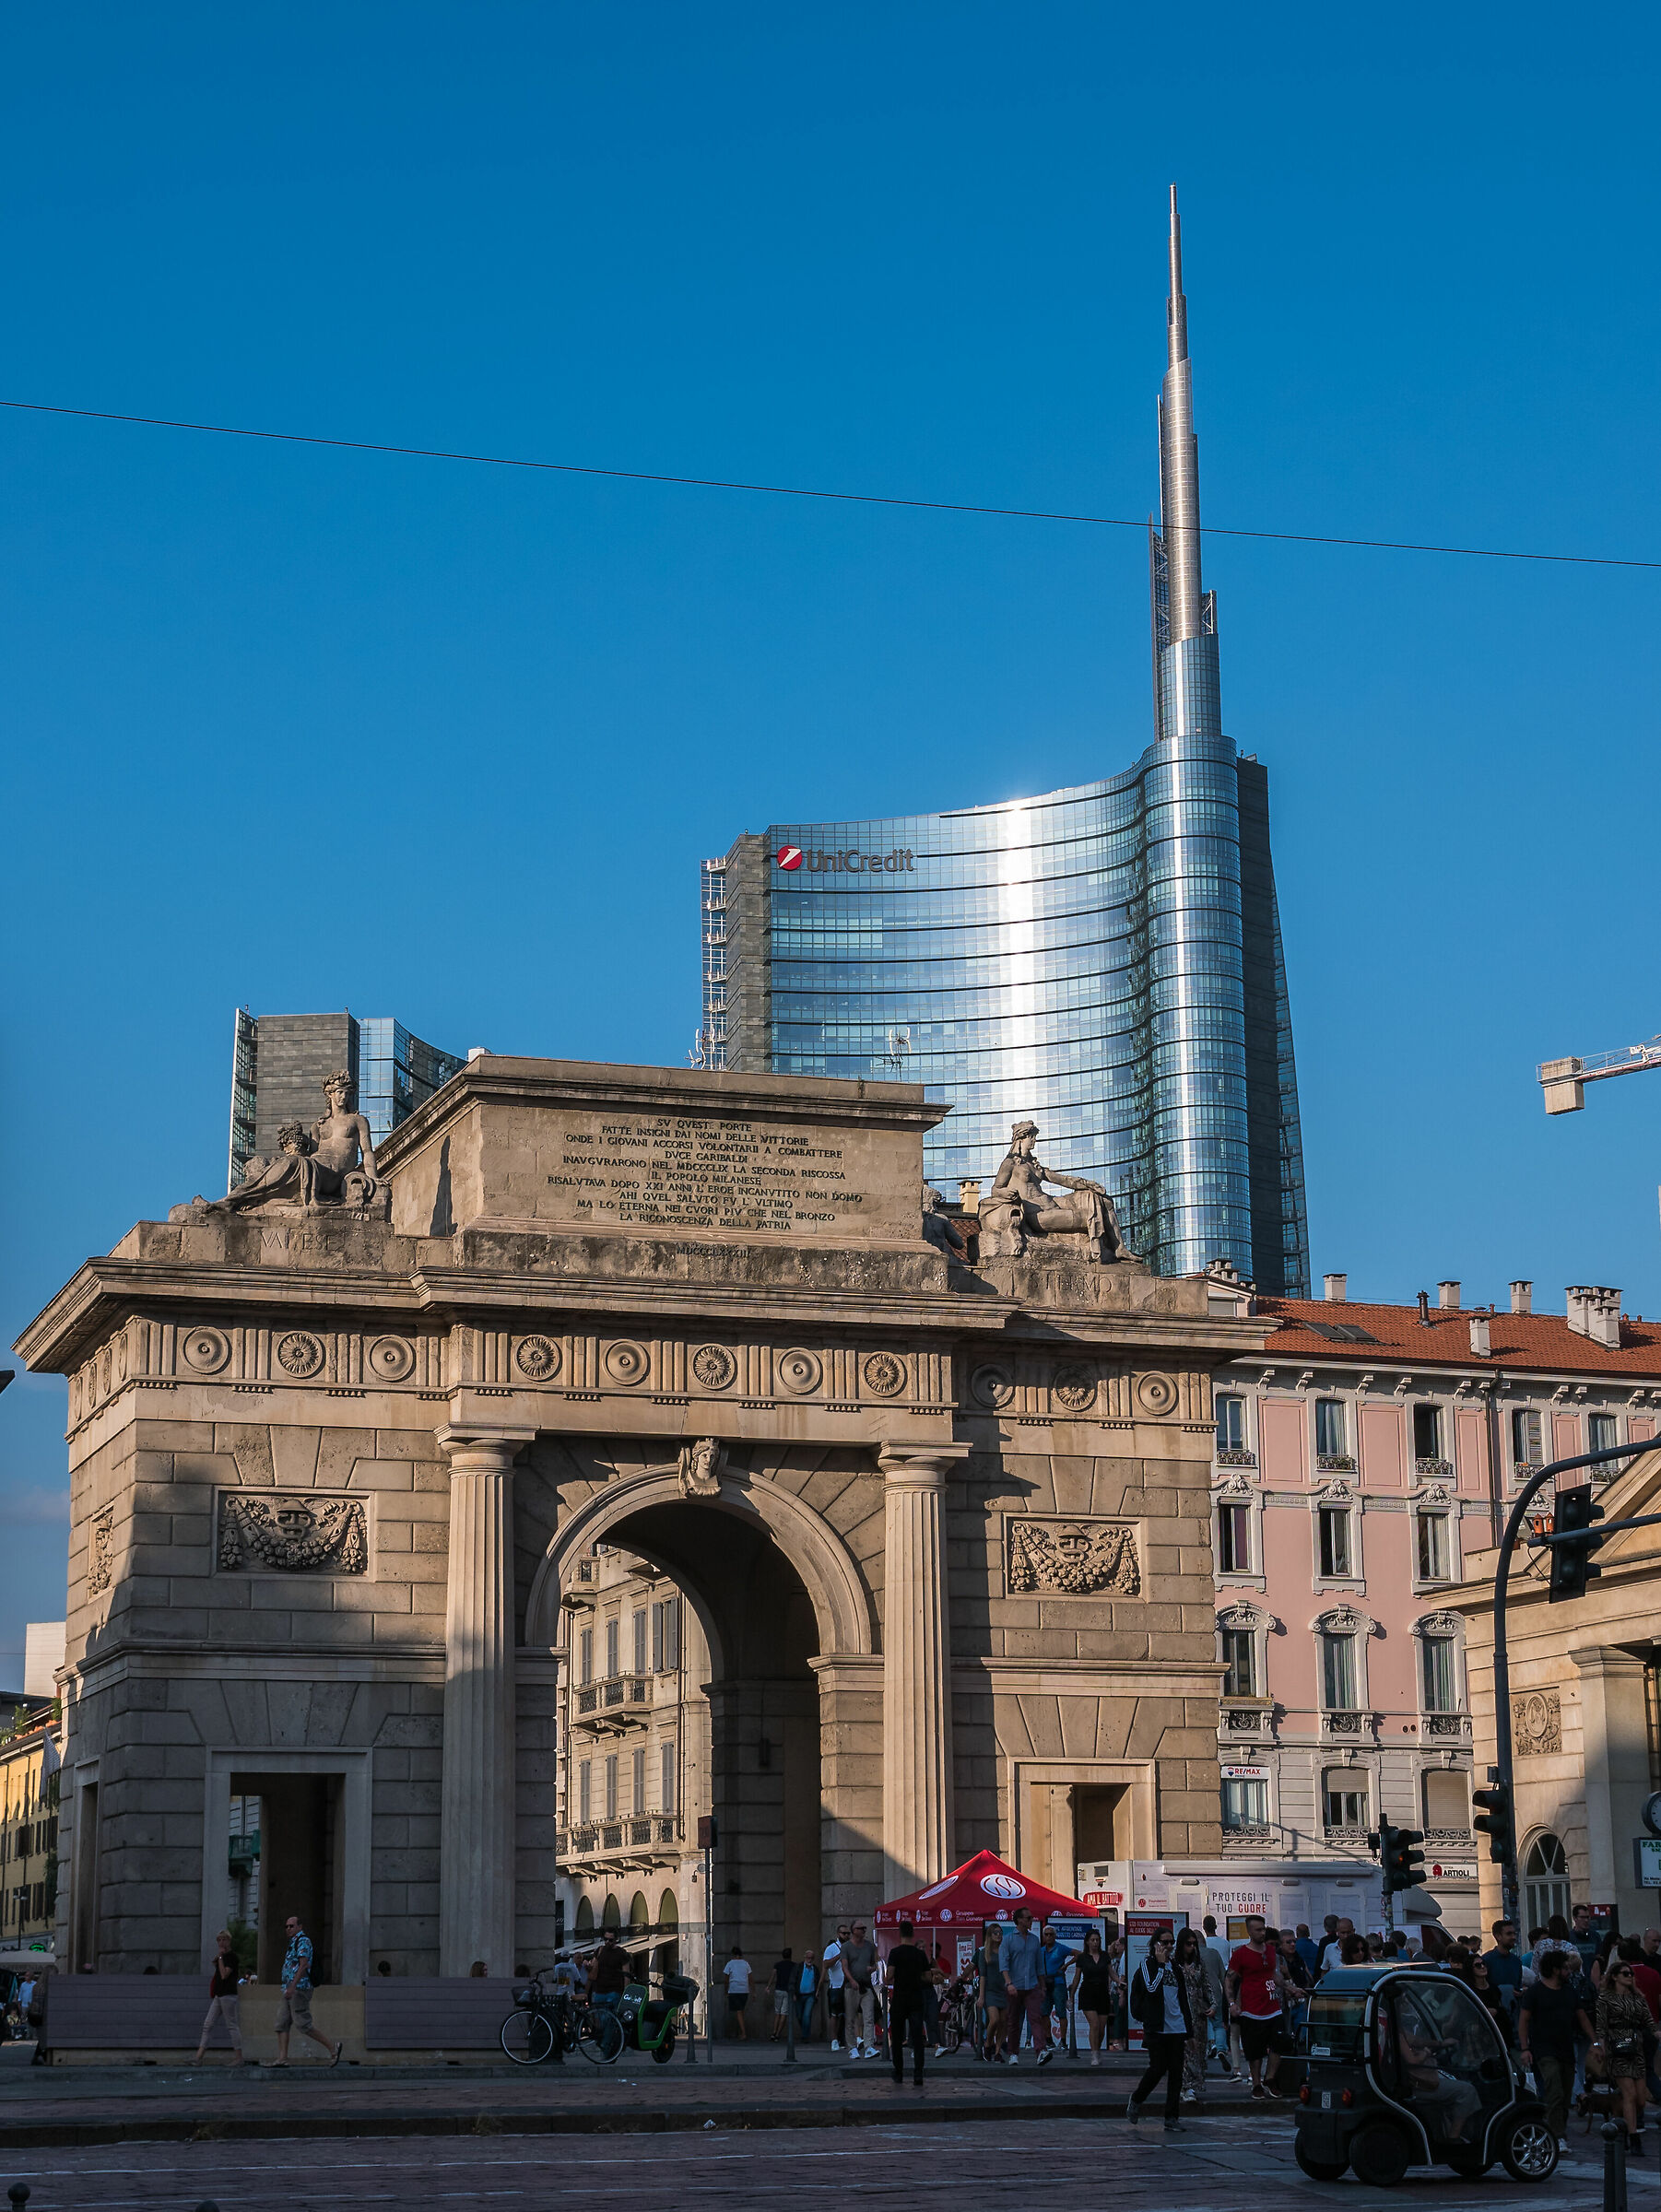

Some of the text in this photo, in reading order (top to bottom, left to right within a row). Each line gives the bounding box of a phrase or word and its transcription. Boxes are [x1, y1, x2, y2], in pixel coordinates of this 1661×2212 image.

[807, 849, 915, 873] UniCredit
[602, 1126, 808, 1146] FATTE INSIGNI DAI NOMI DELLE VITTORIE
[720, 1123, 752, 1132] PORTE
[565, 1135, 593, 1144] ONDE
[607, 1136, 648, 1147] GIOVANI
[653, 1139, 692, 1149] ACCORSI
[699, 1141, 759, 1153] VOLONTARII
[764, 1146, 771, 1154] A
[778, 1147, 842, 1159] COMBATTERE
[665, 1150, 748, 1163] DVCE GARIBALDI
[563, 1155, 845, 1180] INAVGVRARONO NEL MDCCCLIX LA SECONDA RISCOSSA
[652, 1171, 761, 1185] IL POPOLO MILANESE
[548, 1176, 606, 1187] RISALVTAVA
[611, 1180, 640, 1189] DOPO
[645, 1182, 663, 1191] XXI
[668, 1183, 691, 1193] ANNI
[708, 1184, 734, 1194] EROE
[738, 1186, 800, 1198] INCANVTITO
[805, 1191, 828, 1200] NON
[831, 1192, 863, 1203] DOMO
[619, 1191, 637, 1200] AHI
[642, 1193, 671, 1202] QVEL
[677, 1194, 718, 1204] SALVTO
[723, 1197, 736, 1206] FV
[755, 1198, 793, 1208] VLTIMO
[577, 1200, 835, 1221] MA LO ETERNA NEI CVORI PIV CHE NEL BRONZO
[619, 1213, 791, 1231] LA RICONOSCENZA DELLA PATRIA
[1212, 1892, 1269, 1902] PROTEGGI IL
[1216, 1903, 1266, 1913] TUO CUORE
